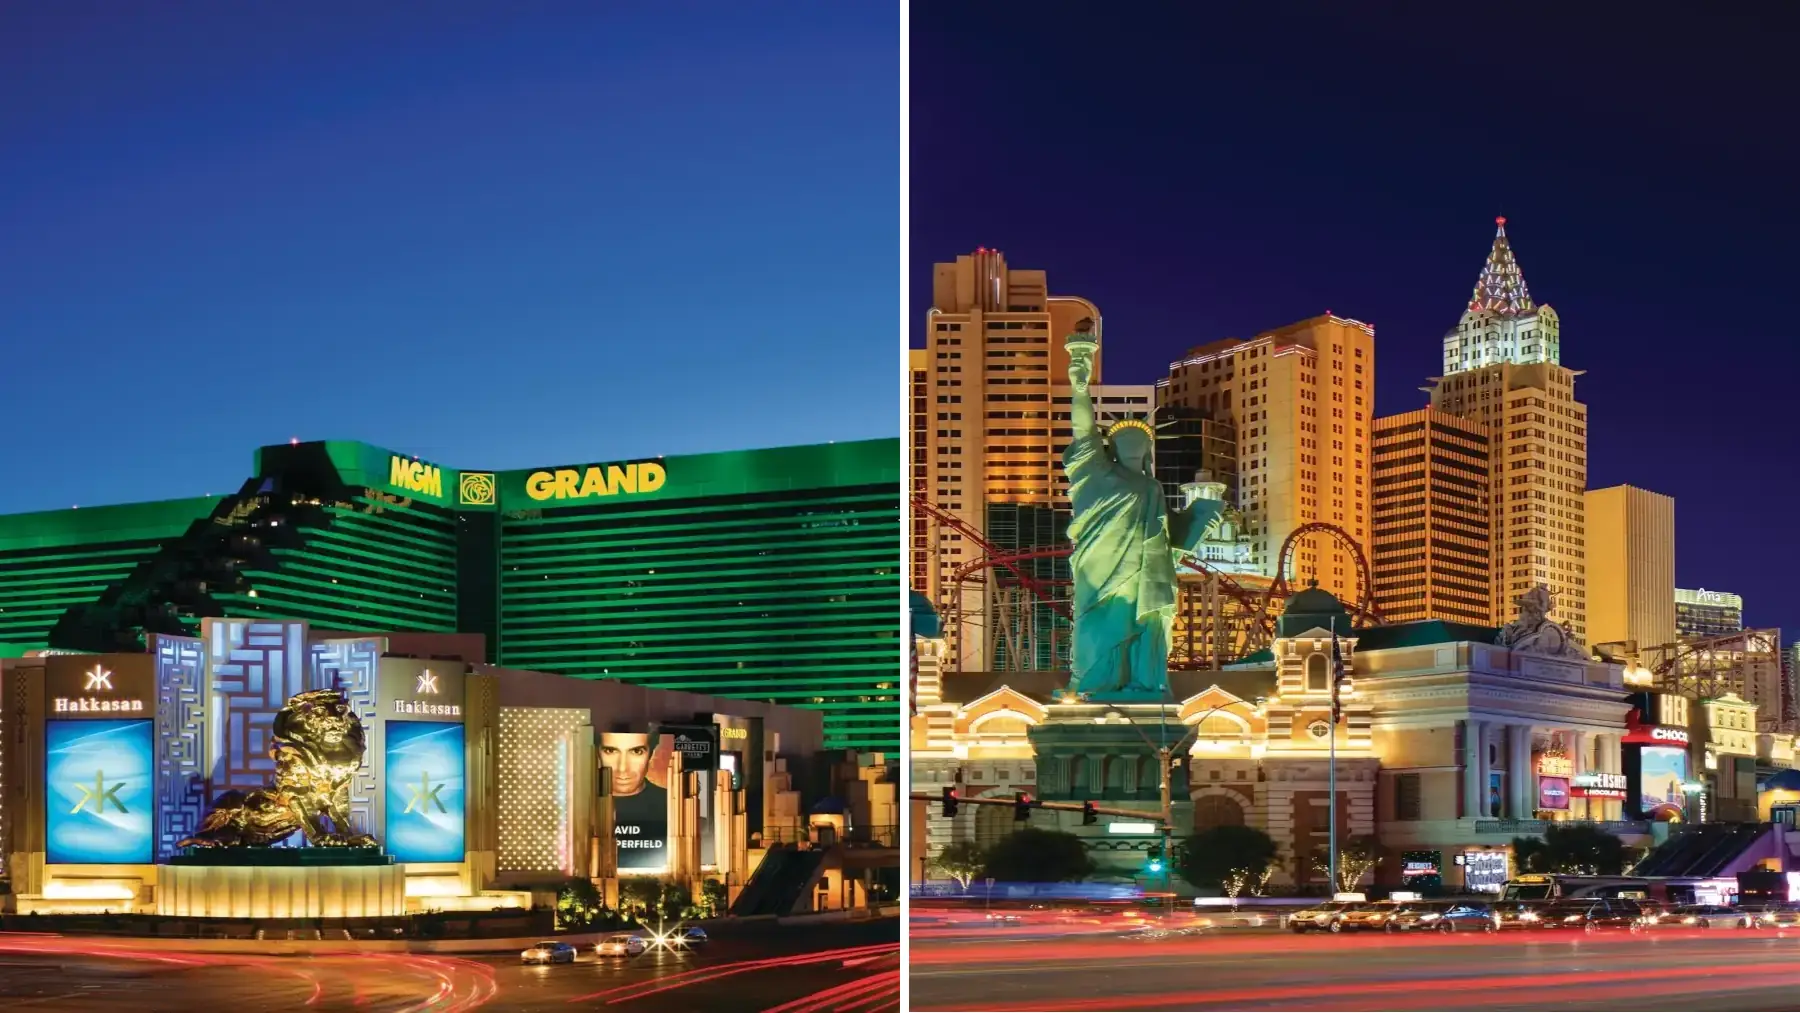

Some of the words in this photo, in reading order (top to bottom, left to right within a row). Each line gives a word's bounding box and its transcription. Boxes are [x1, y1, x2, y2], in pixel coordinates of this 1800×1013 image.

[389, 455, 442, 498] MGM
[525, 462, 666, 501] GRAND
[54, 697, 144, 712] Hakkasan
[393, 699, 462, 715] Hakkasan
